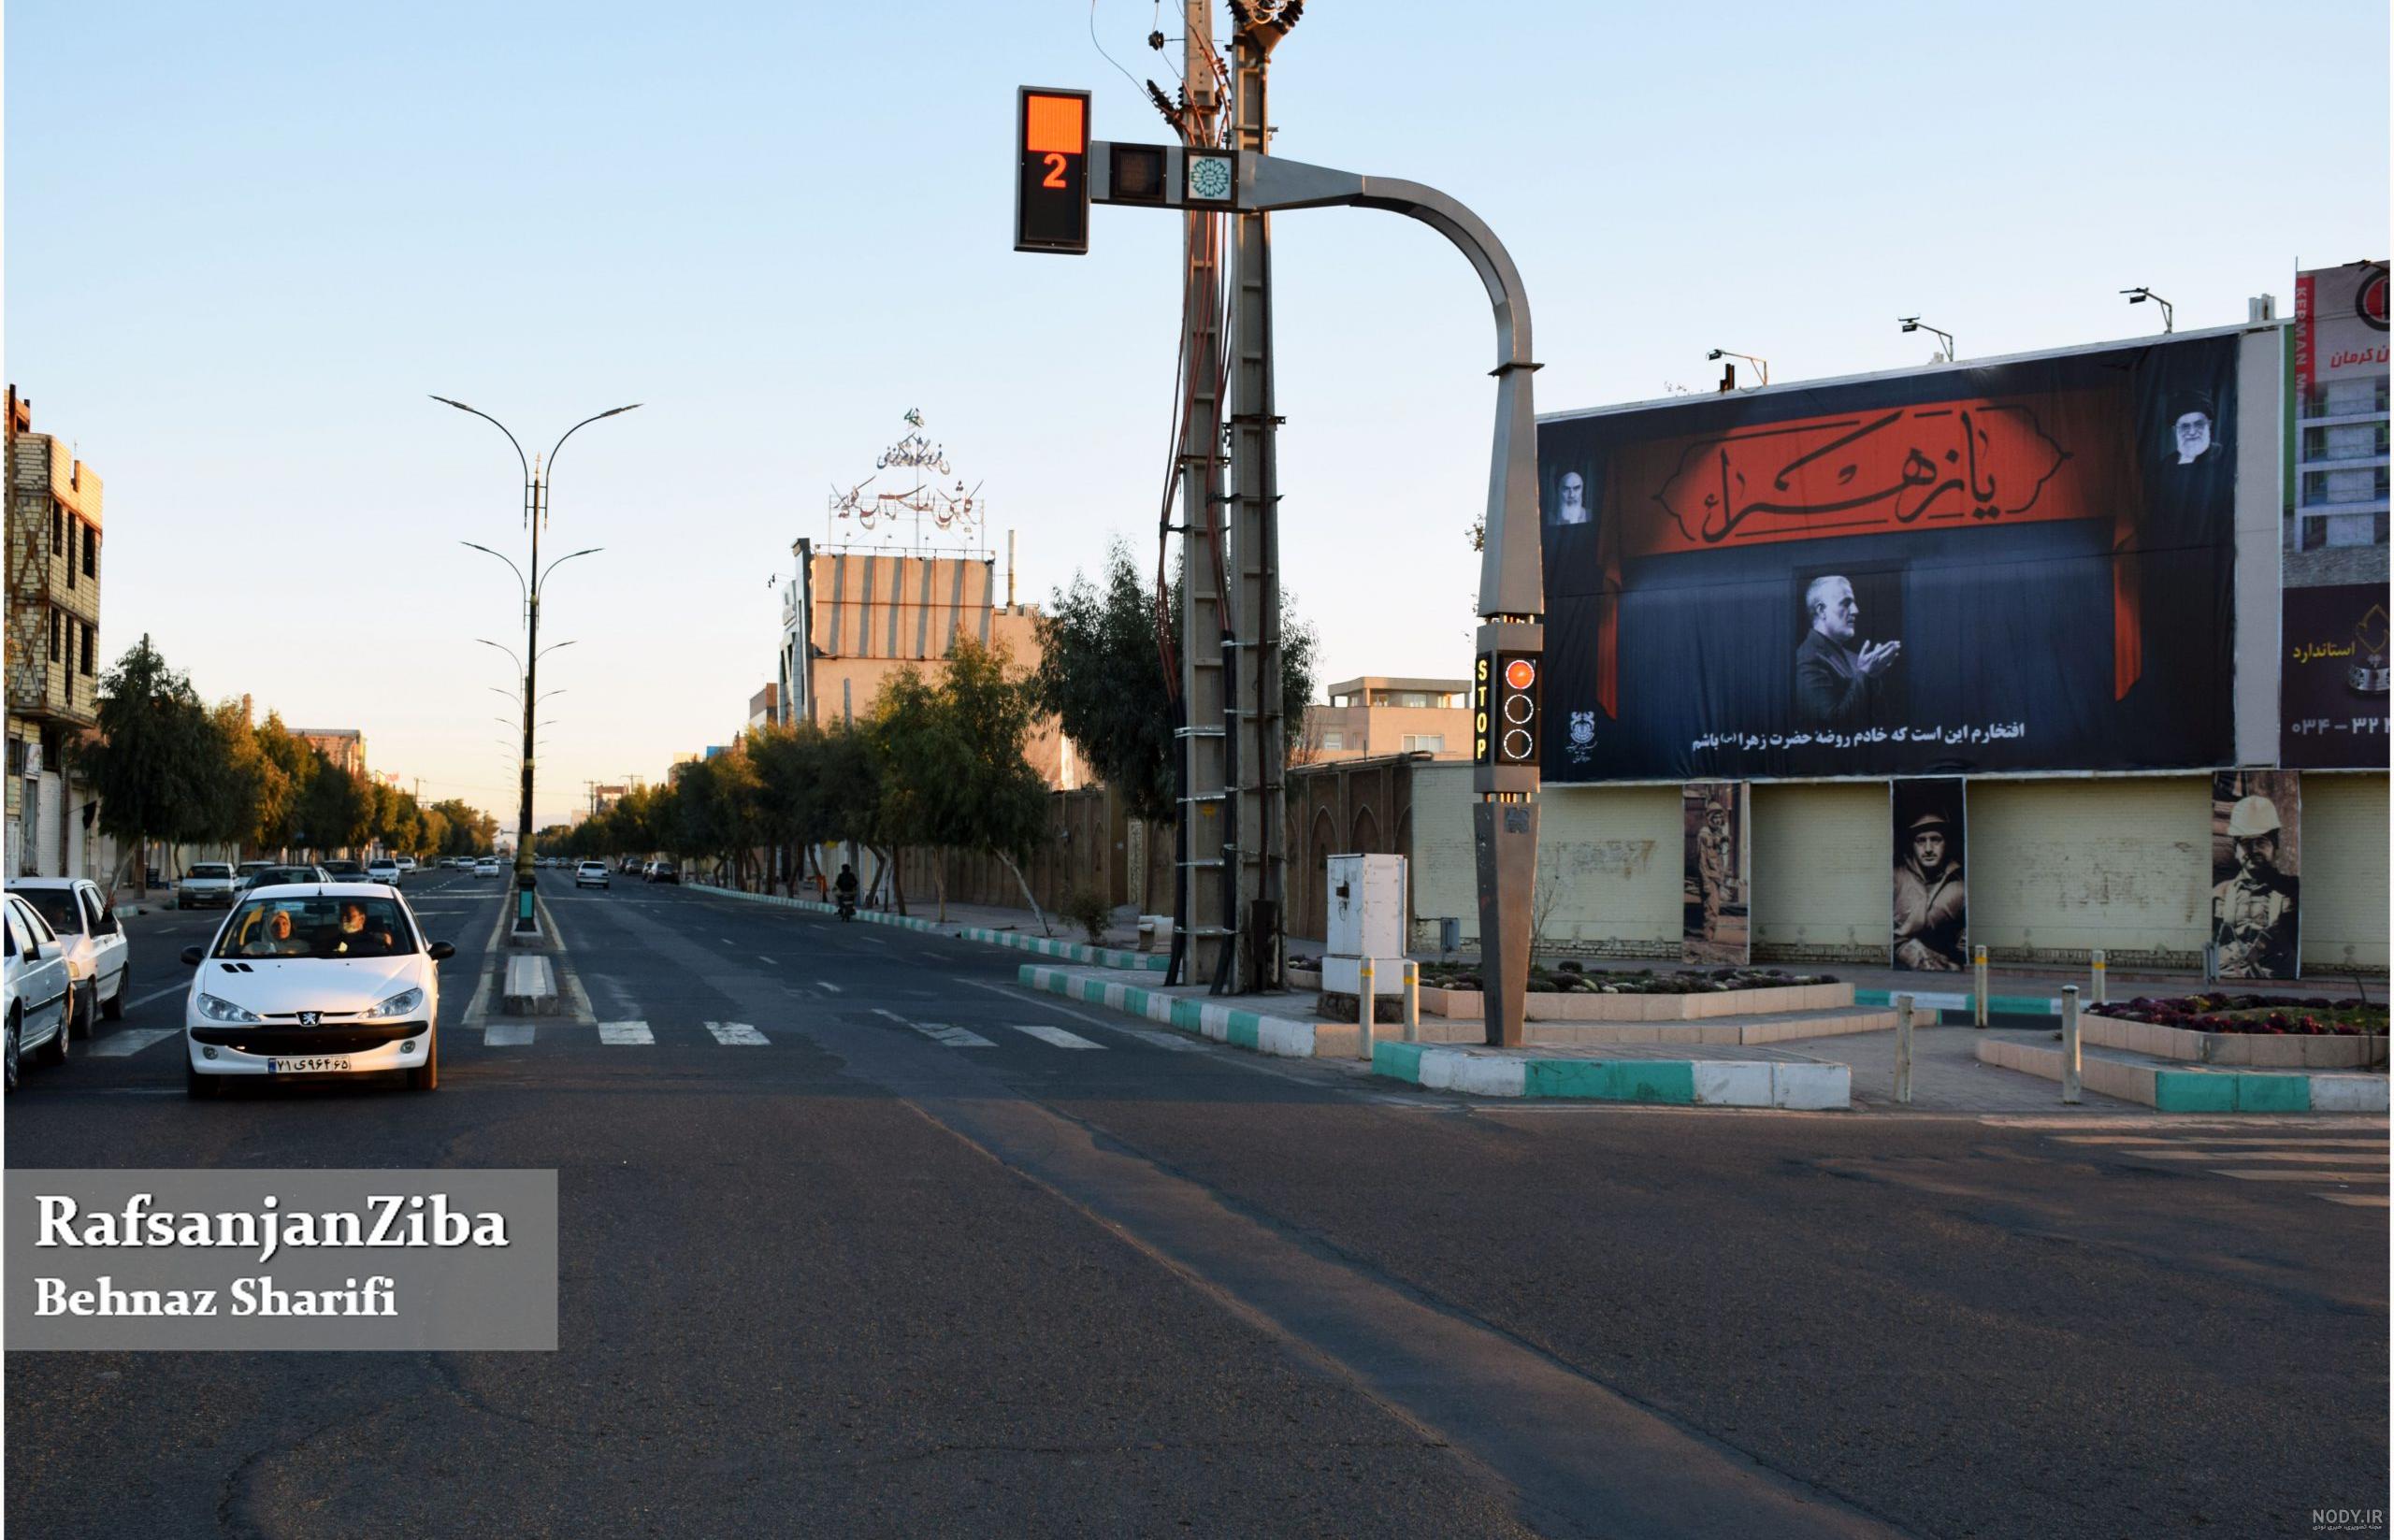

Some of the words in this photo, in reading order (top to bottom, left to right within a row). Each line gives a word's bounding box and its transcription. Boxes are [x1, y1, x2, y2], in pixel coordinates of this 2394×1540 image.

[1043, 152, 1067, 188] 2
[2295, 287, 2307, 366] KERMAN
[2330, 348, 2373, 367] کرمان
[2293, 641, 2356, 664] استاندارد
[1477, 659, 1488, 759] STOP
[1692, 732, 1719, 751] باشم
[1769, 729, 1812, 749] حضرت
[1853, 727, 1887, 747] خادم
[1891, 726, 1909, 741] که
[1911, 725, 1941, 741] است
[1944, 724, 1969, 744] این
[1971, 721, 2026, 744] افتخارم
